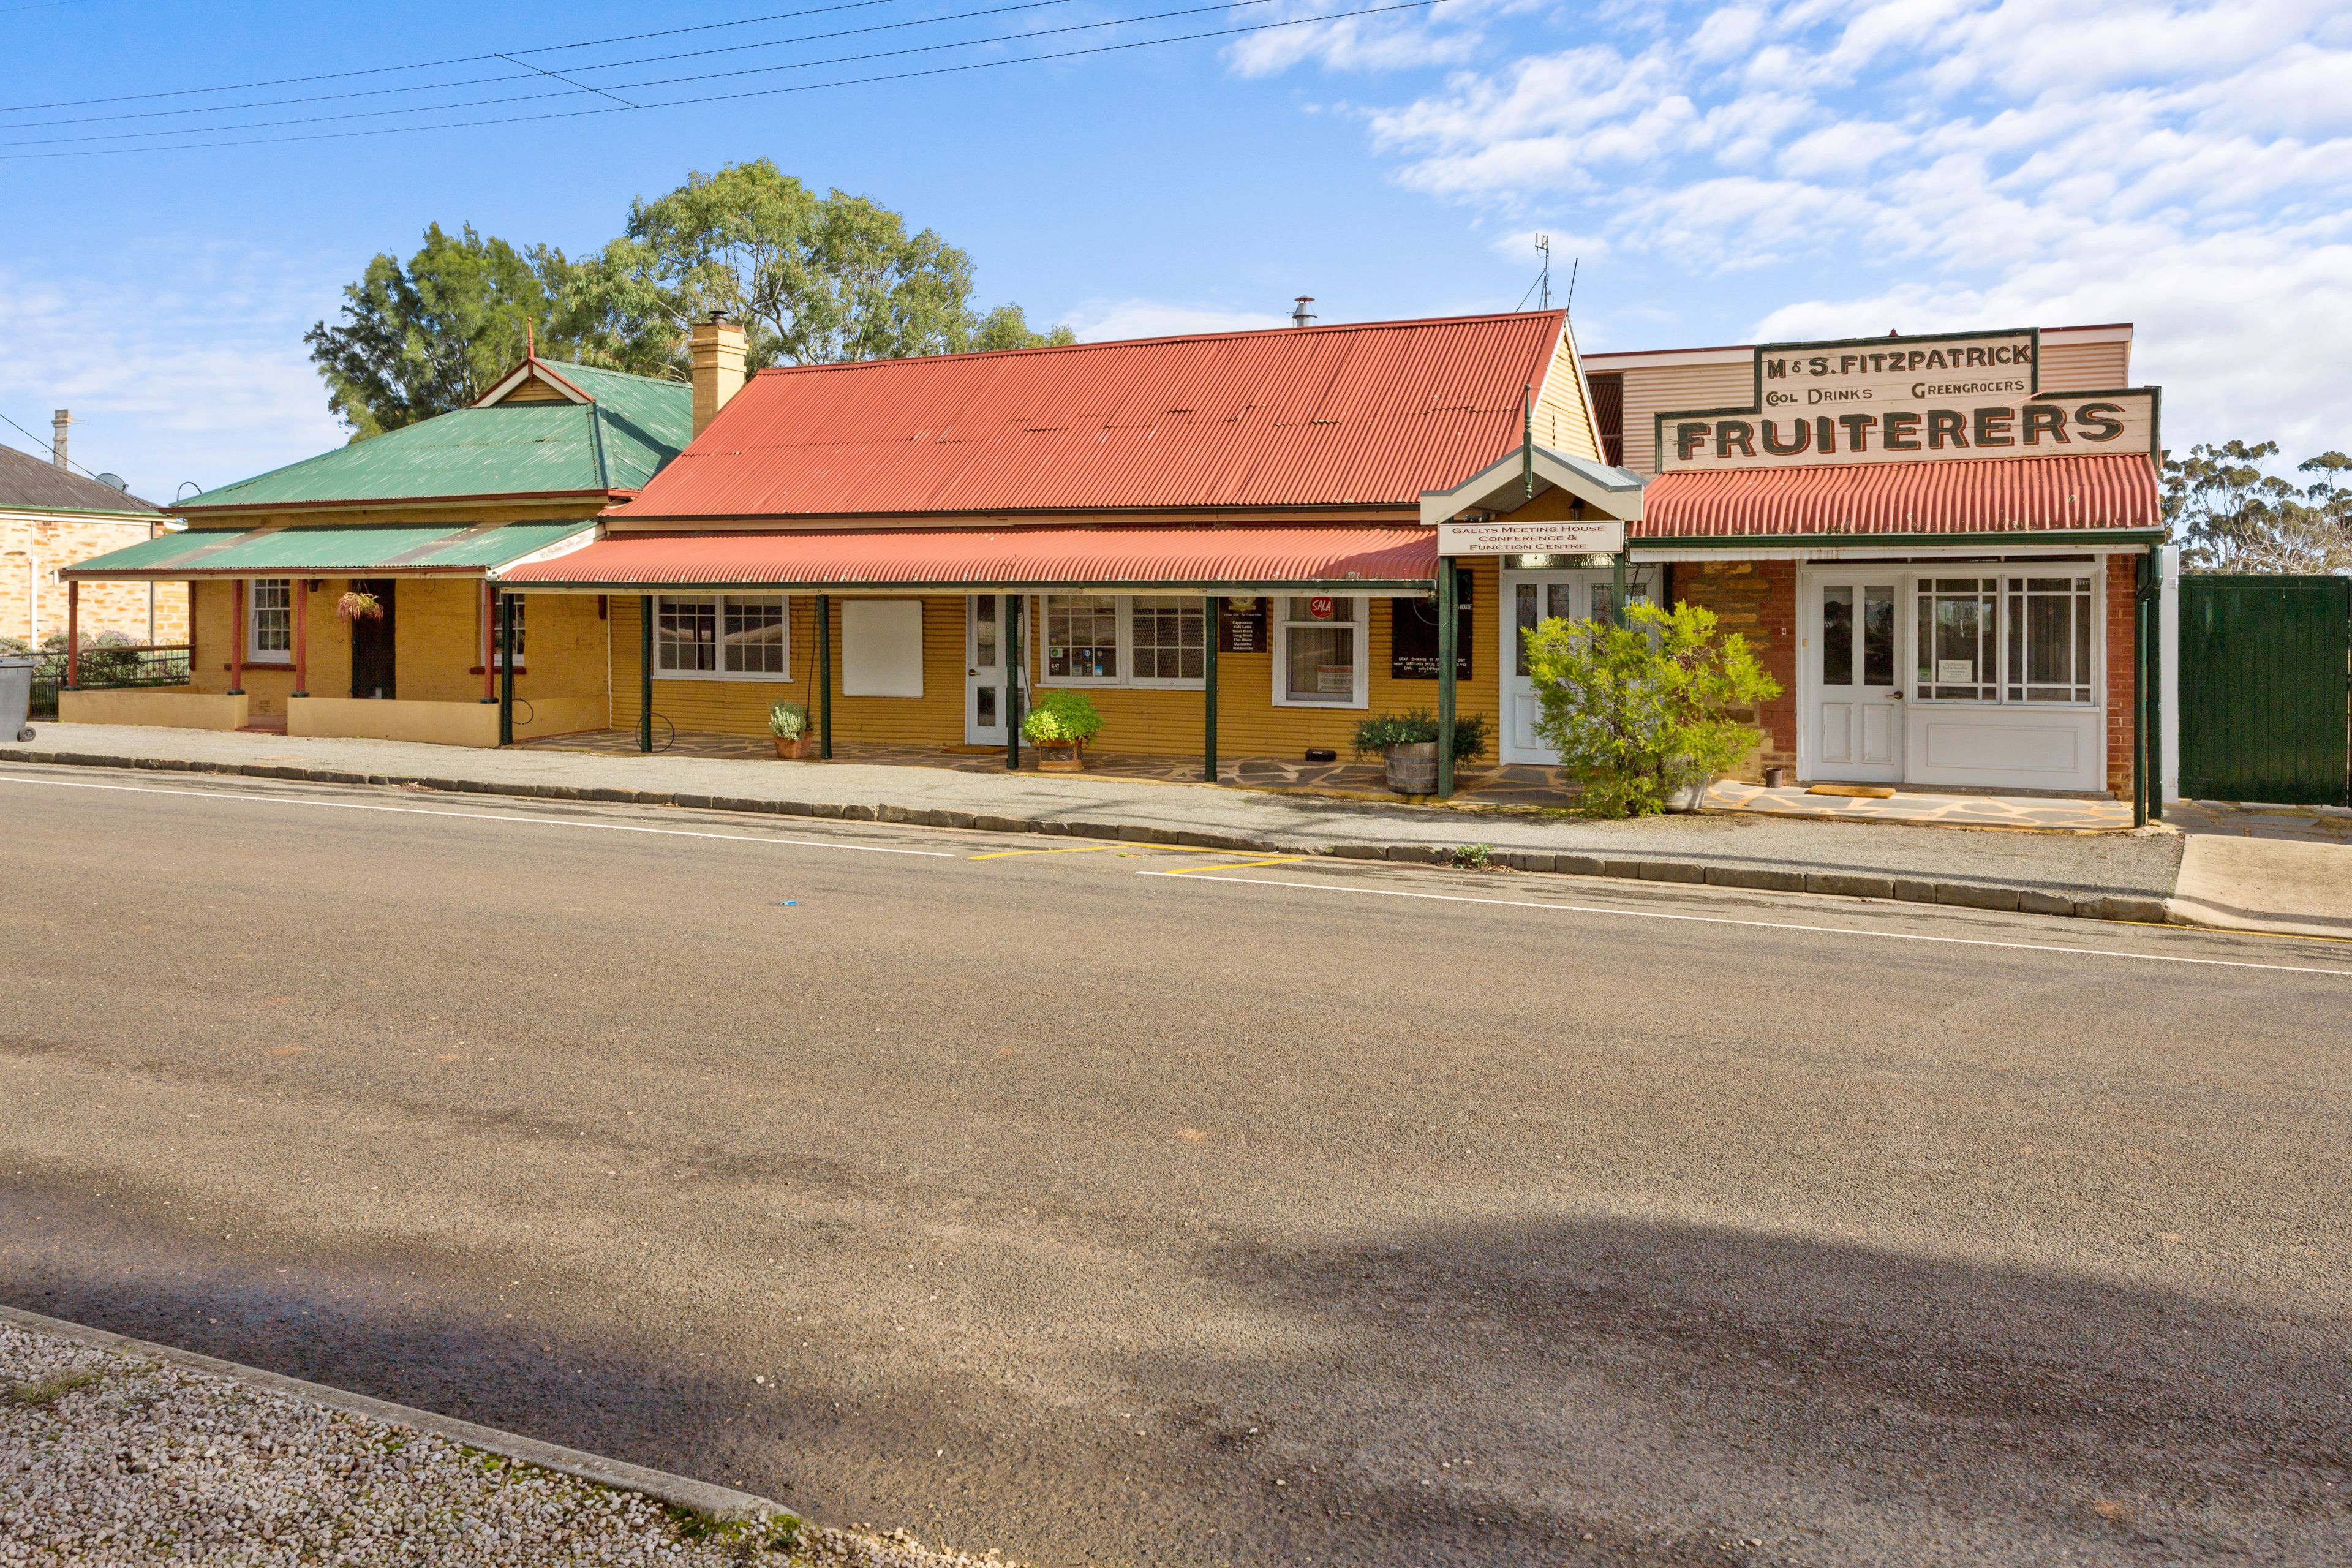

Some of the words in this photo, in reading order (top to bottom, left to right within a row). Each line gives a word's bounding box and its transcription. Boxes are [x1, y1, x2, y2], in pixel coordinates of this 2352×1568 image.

[1767, 358, 1787, 379] M
[1792, 361, 1801, 374] &
[1808, 388, 1872, 405] DRINKS
[1911, 380, 2024, 398] GREENGROCERS
[1676, 402, 2126, 461] FRUITERERS
[1312, 599, 1332, 612] SALA
